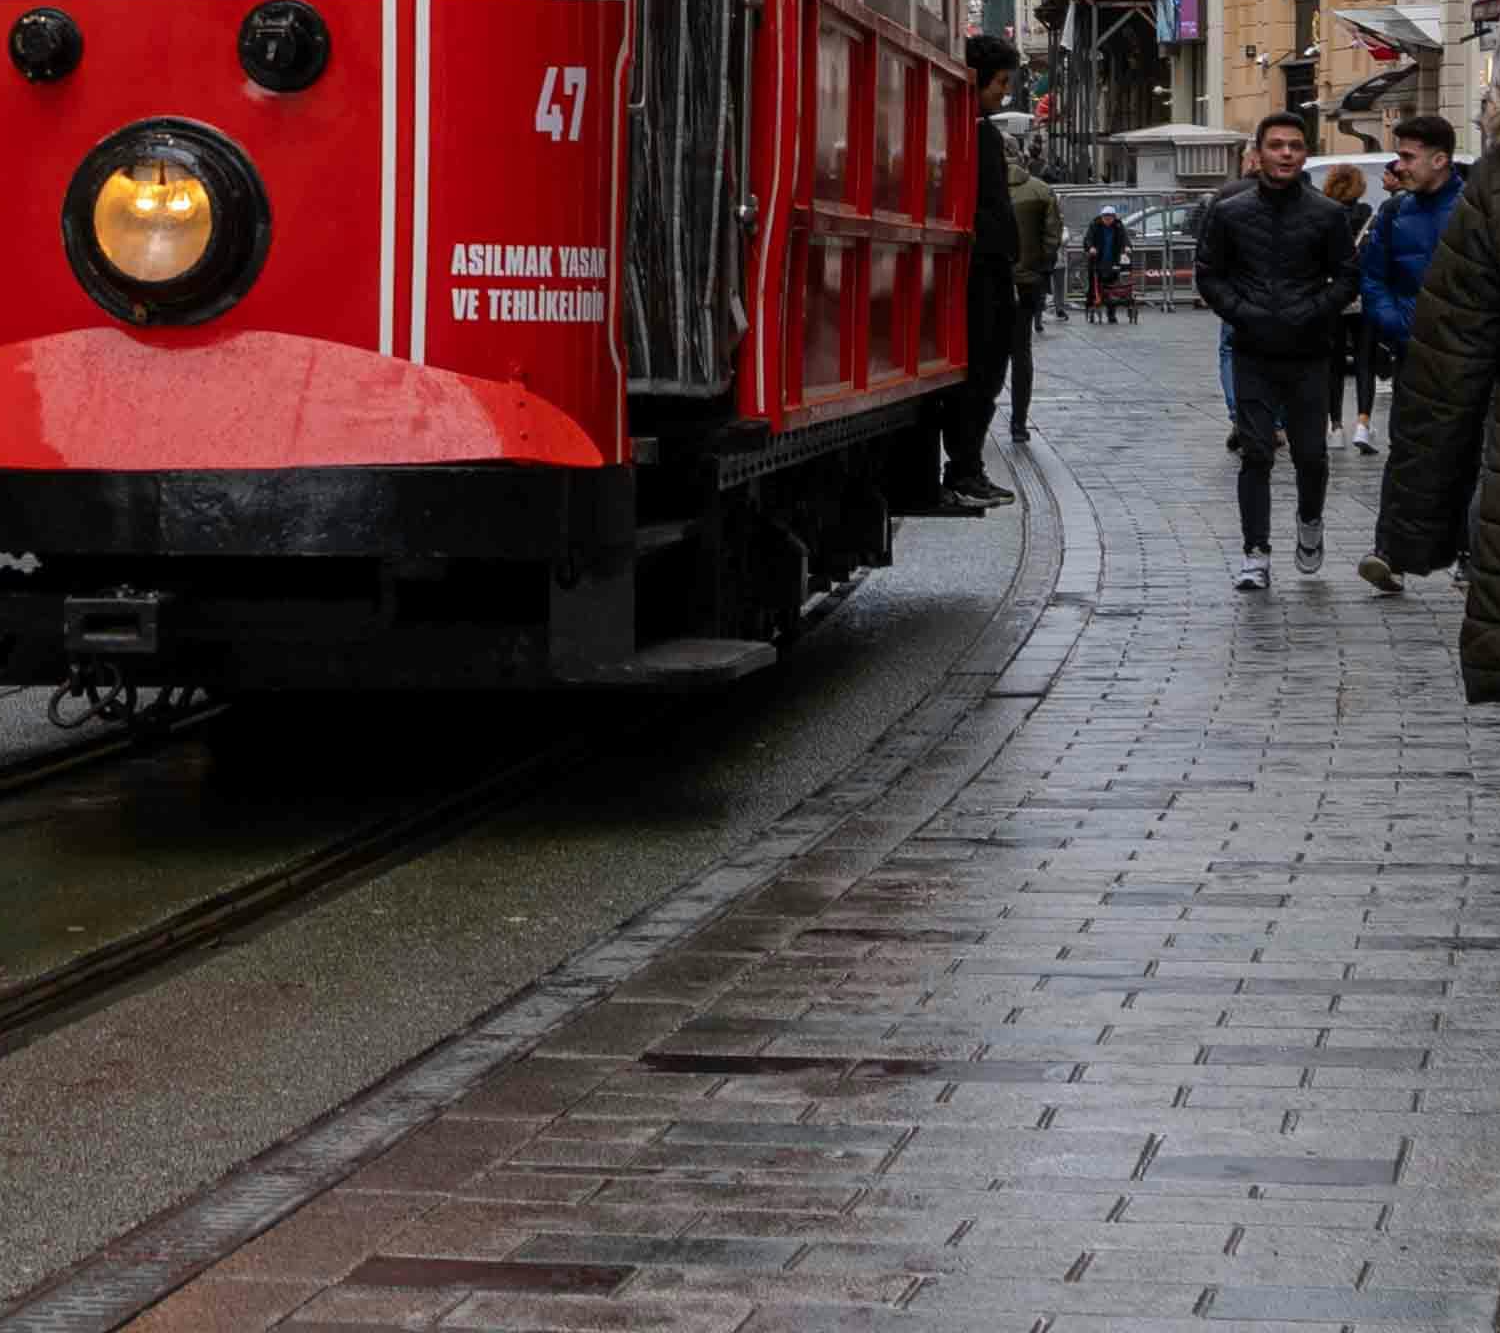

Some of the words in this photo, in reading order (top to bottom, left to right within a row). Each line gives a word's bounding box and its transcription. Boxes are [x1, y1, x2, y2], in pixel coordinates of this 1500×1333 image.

[535, 66, 588, 142] 47
[451, 243, 553, 277] ASILMAK
[558, 246, 607, 278] YASAK
[451, 288, 480, 321] VE
